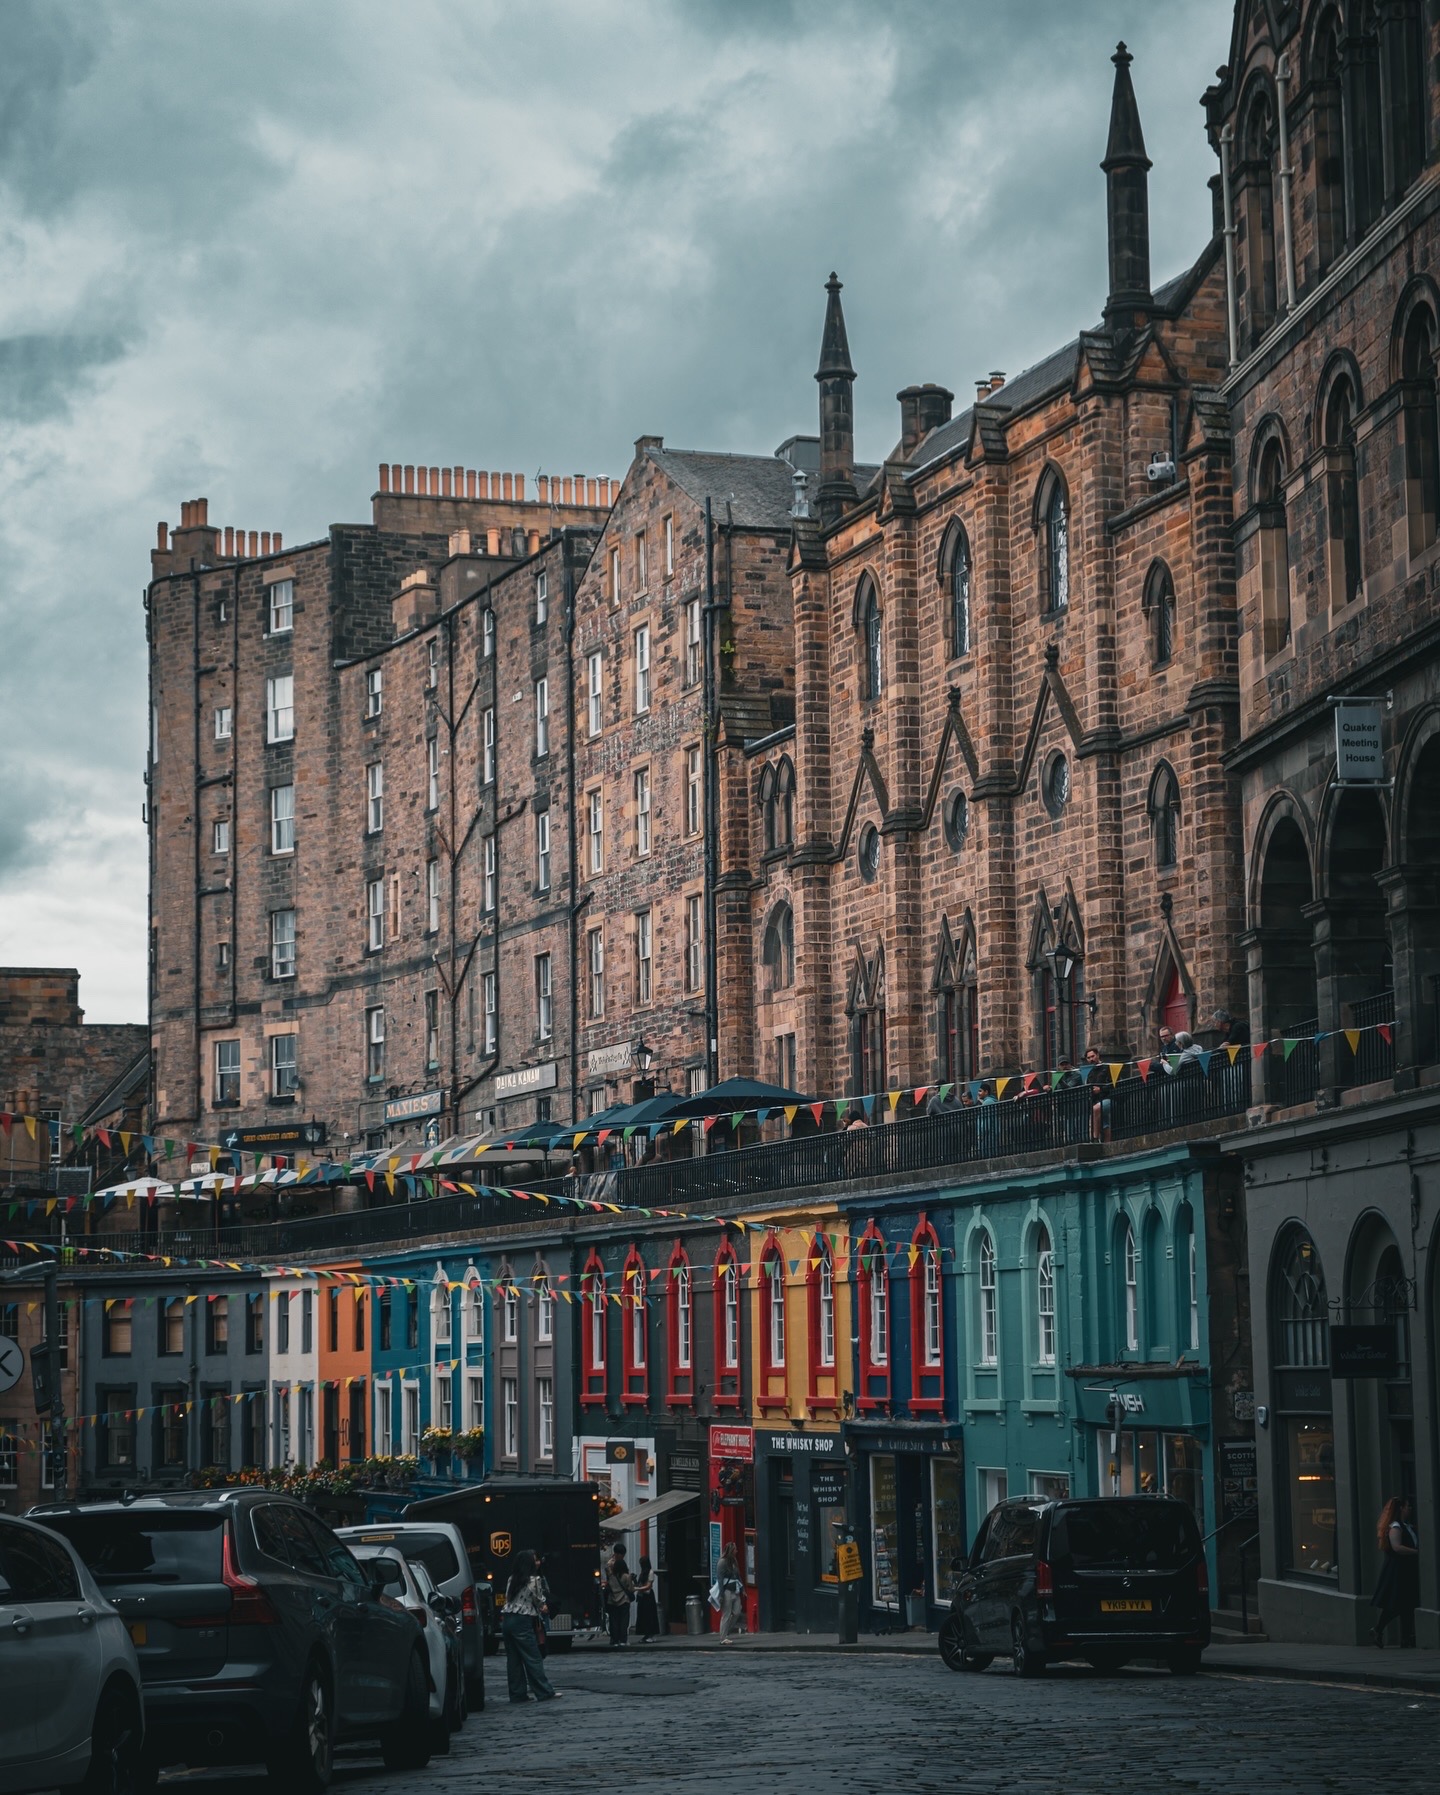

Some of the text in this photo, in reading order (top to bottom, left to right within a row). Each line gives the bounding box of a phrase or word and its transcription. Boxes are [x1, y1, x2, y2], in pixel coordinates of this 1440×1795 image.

[1343, 724, 1376, 732] Quaker
[1342, 739, 1379, 749] Meeting
[1346, 754, 1376, 762] House
[387, 1098, 428, 1118] MAXIES
[720, 1433, 739, 1447] ELEPHANT
[771, 1436, 833, 1452] THE WHISKY SHOP
[692, 1458, 700, 1468] SON
[492, 1540, 510, 1554] ups
[1107, 1601, 1146, 1610] YK19 VYA
